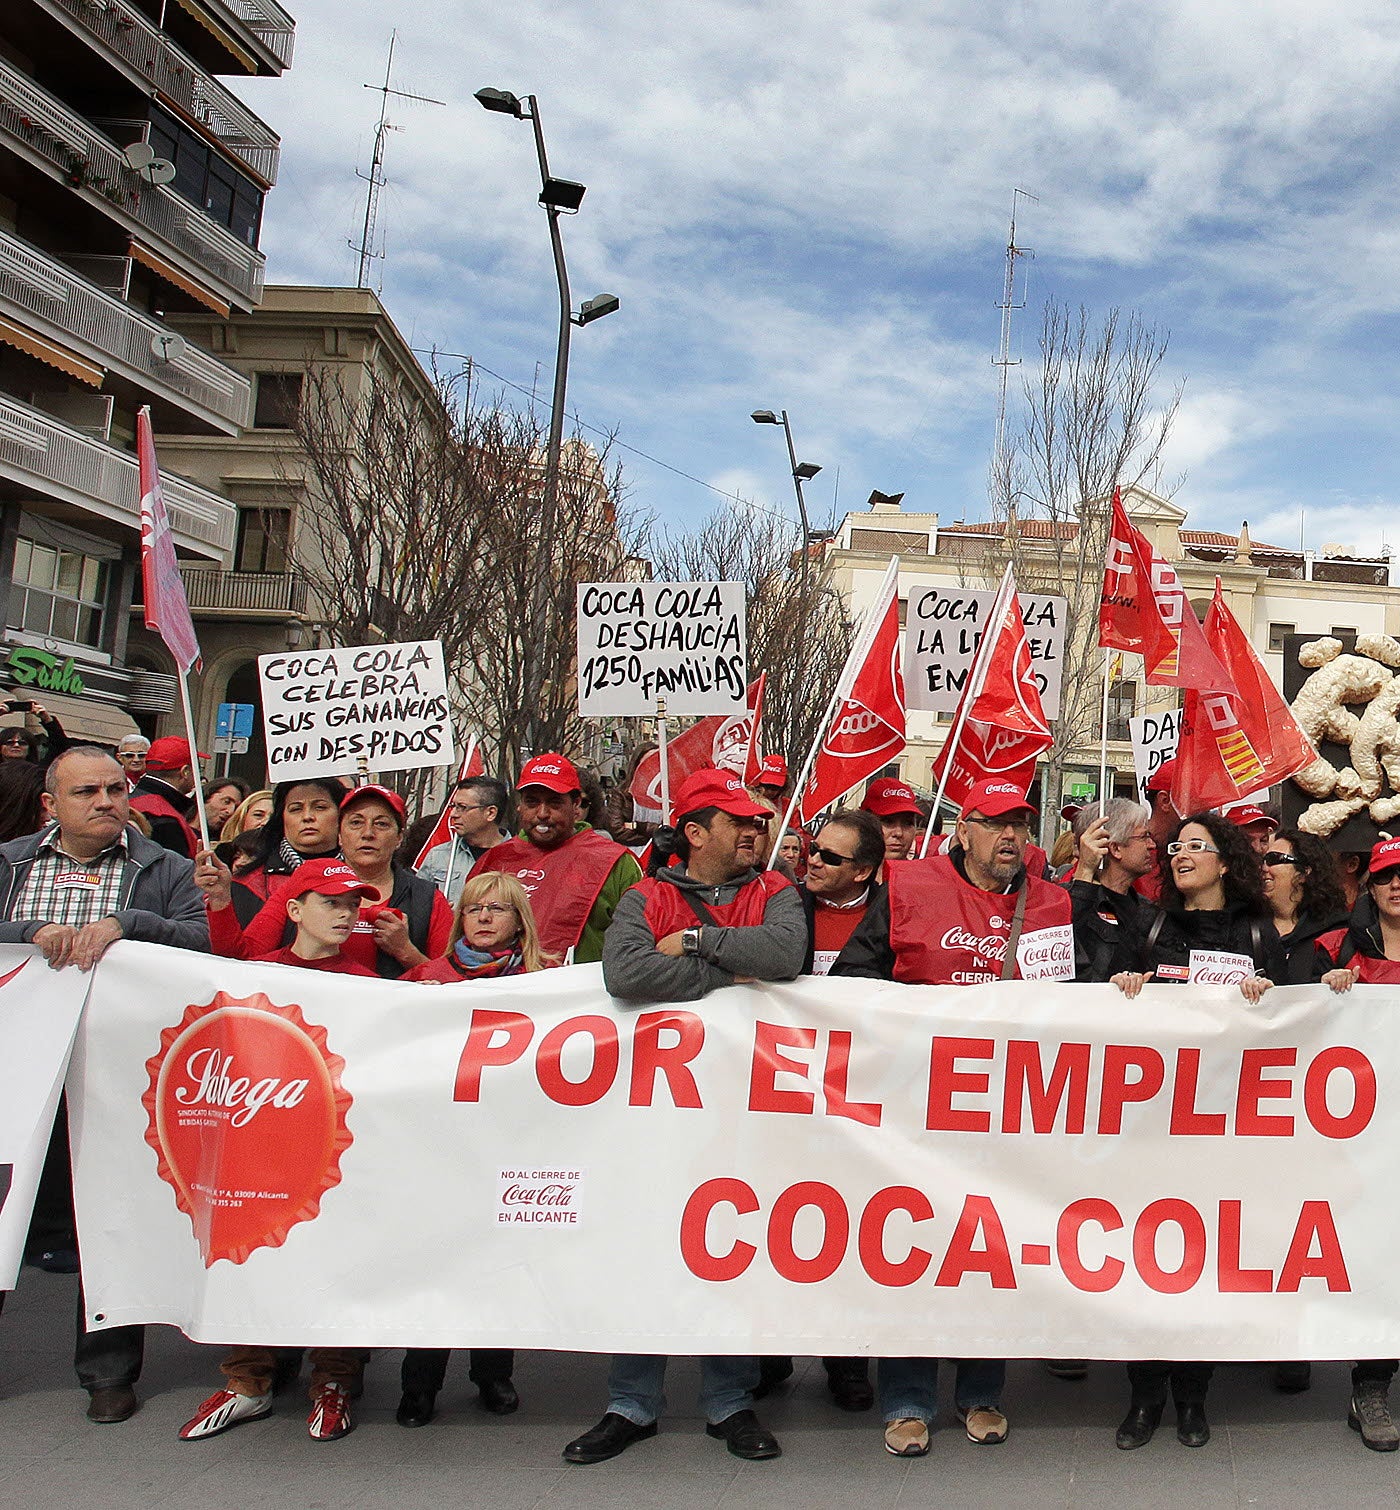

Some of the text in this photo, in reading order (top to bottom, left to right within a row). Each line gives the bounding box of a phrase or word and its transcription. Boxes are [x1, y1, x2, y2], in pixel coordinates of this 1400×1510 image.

[582, 585, 723, 619] COCA COLA
[917, 590, 979, 623] COCA
[916, 629, 945, 655] LA
[265, 645, 433, 681] COCA COLA
[582, 654, 641, 699] 1250
[282, 671, 420, 703] CELEBRA
[268, 711, 316, 736] SUS
[270, 743, 308, 765] CON
[454, 1008, 705, 1109] POR
[748, 1020, 883, 1127] EL
[925, 1035, 1377, 1139] EMPLEO
[501, 1171, 515, 1179] NO
[517, 1171, 529, 1179] AL
[532, 1171, 566, 1179] CIERRE
[502, 1183, 577, 1206] Coca-Cola
[498, 1211, 577, 1223] EN ALICANTE
[680, 1177, 1352, 1295] COCA-COLA
